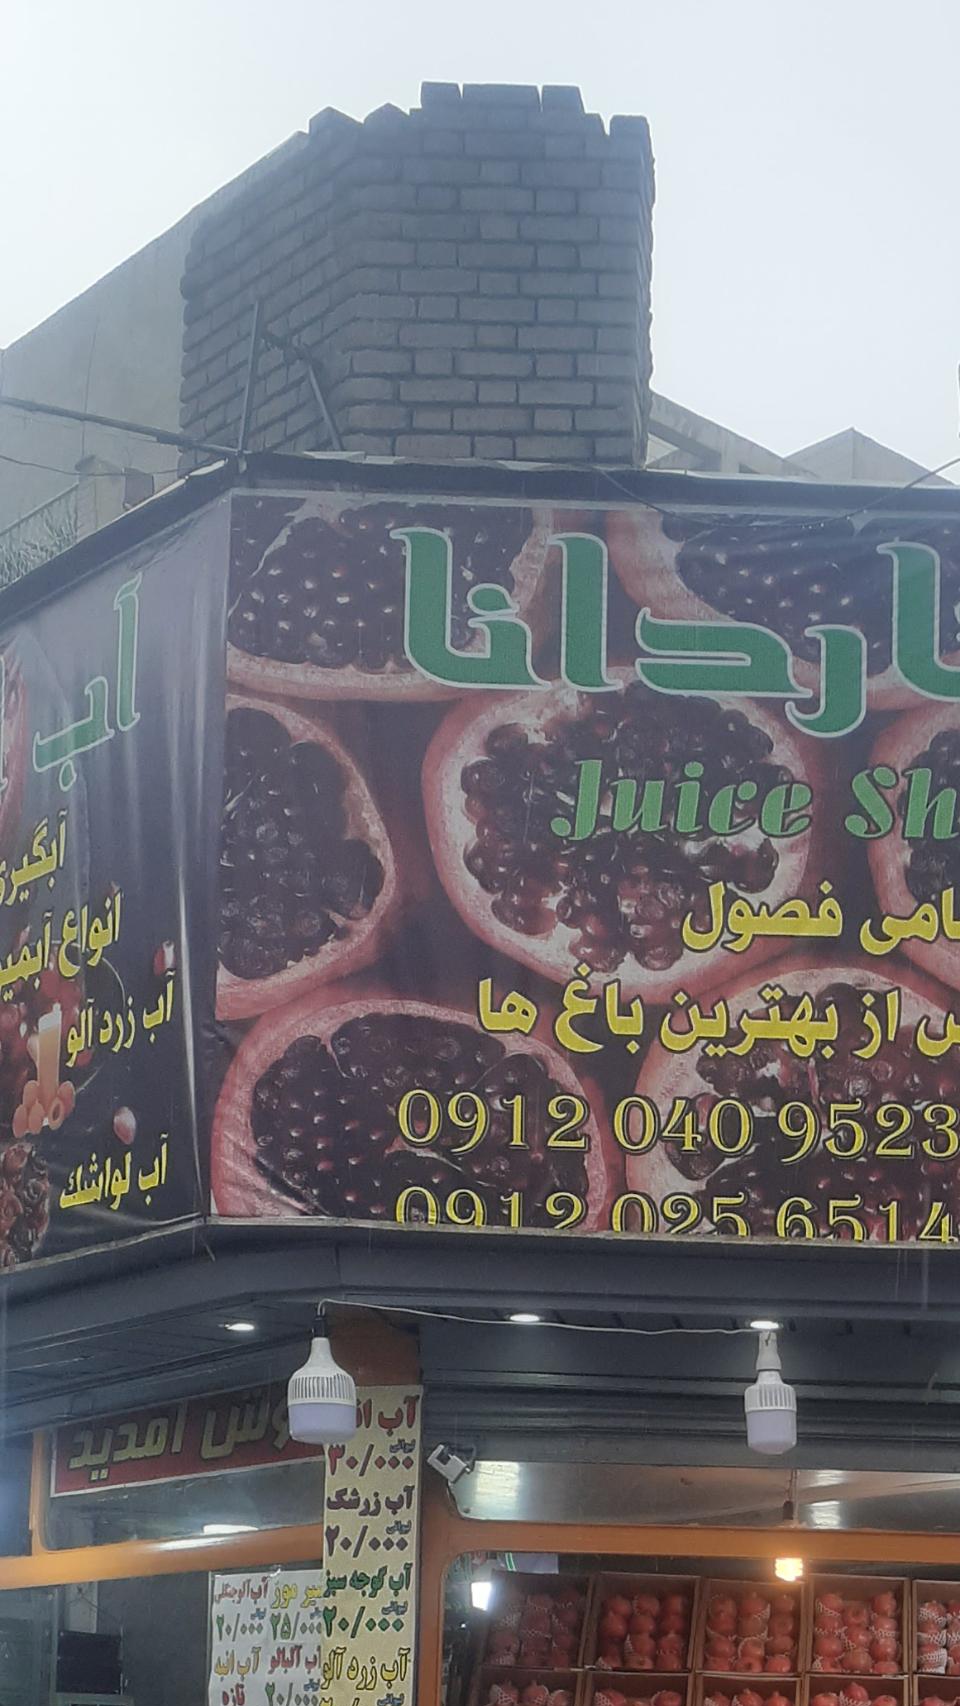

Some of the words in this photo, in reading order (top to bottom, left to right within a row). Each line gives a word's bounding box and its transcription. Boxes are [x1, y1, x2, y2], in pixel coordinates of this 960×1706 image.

[33, 571, 143, 791] آب
[550, 759, 813, 842] Juice
[0, 808, 68, 907] آبگیر
[58, 890, 122, 979] انواع
[682, 881, 843, 952] فصول
[0, 911, 53, 1002] آبمی
[66, 998, 95, 1068] آلو
[99, 995, 136, 1053] زرد
[143, 970, 176, 1043] آب
[479, 978, 537, 1036] ها
[554, 970, 645, 1055] باغ
[660, 988, 841, 1058] بهترین
[856, 990, 899, 1060] از
[397, 1088, 589, 1156] 0912
[613, 1096, 755, 1156] 040
[137, 1132, 169, 1206] آب
[395, 1187, 587, 1232] 0912
[611, 1192, 749, 1237] 025
[777, 1193, 960, 1244] 6514
[377, 1394, 420, 1437] آب
[326, 1487, 382, 1517] زرشک
[385, 1485, 415, 1515] آب
[388, 1562, 413, 1597] آب
[380, 1647, 411, 1690] آب
